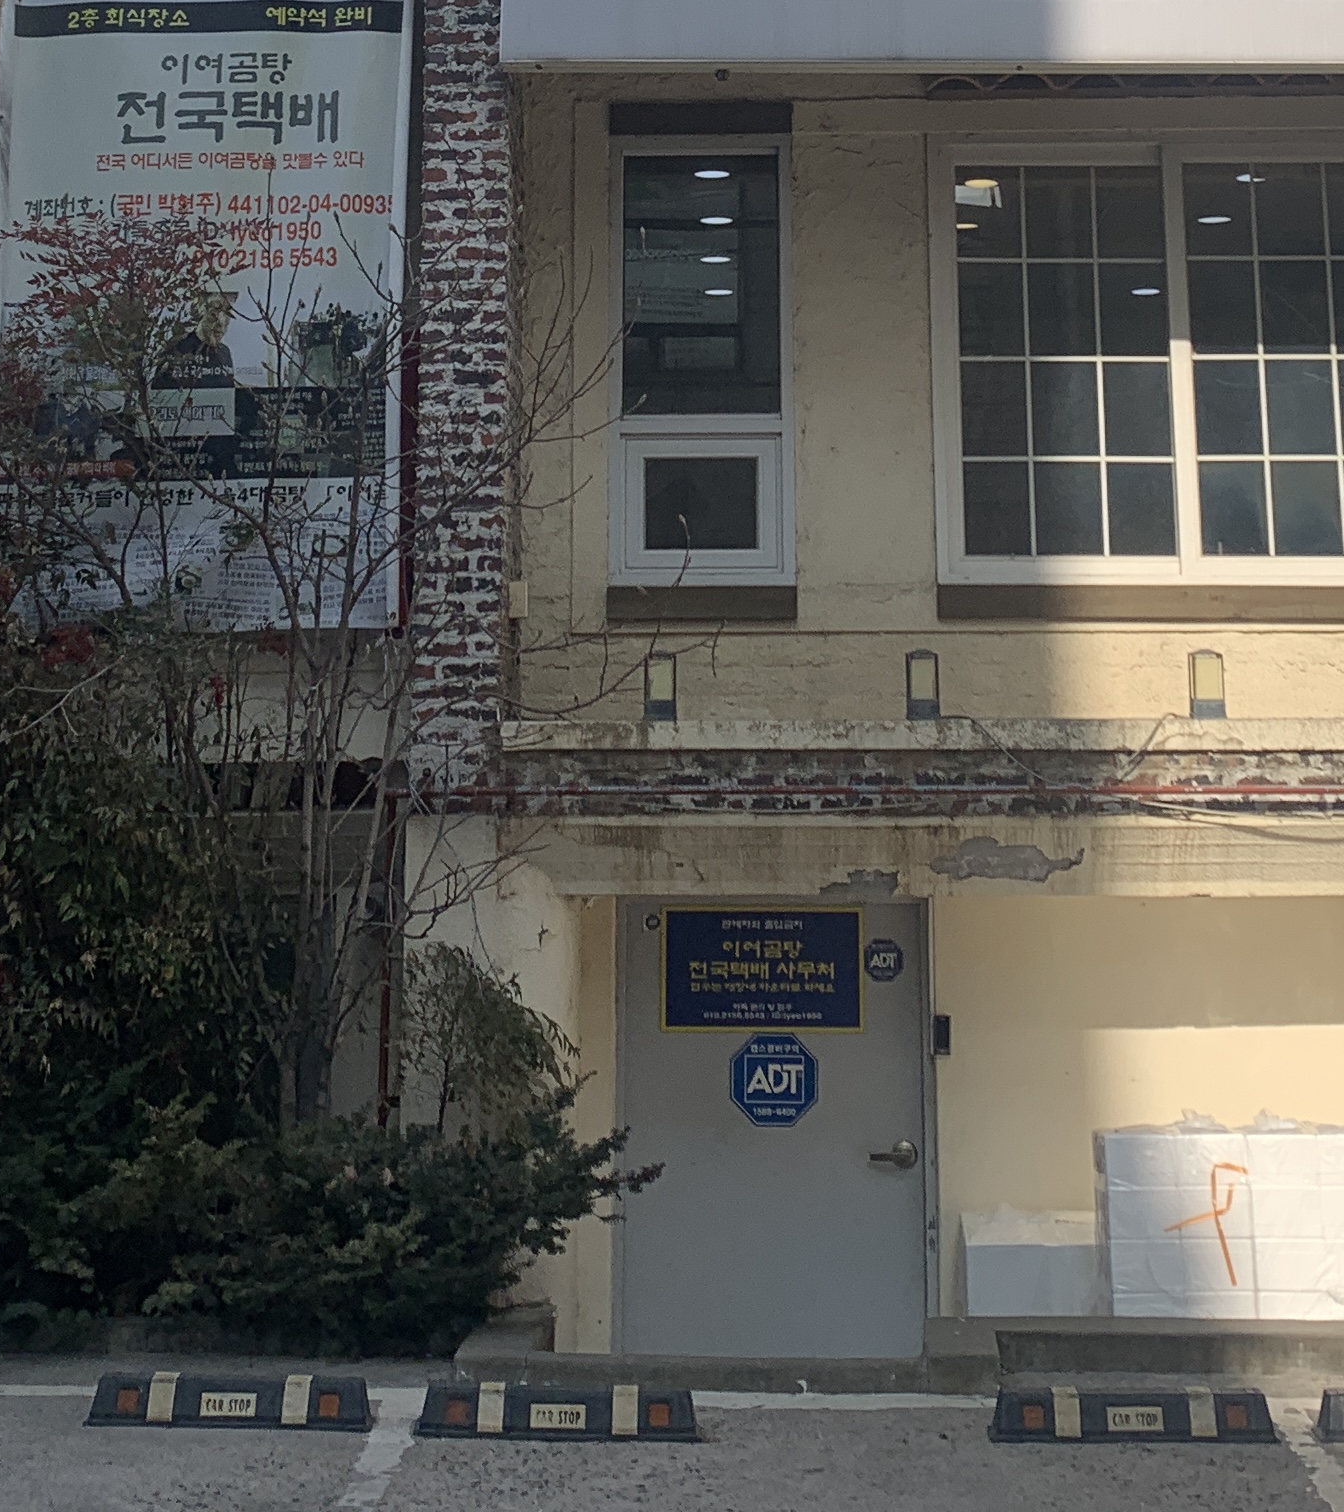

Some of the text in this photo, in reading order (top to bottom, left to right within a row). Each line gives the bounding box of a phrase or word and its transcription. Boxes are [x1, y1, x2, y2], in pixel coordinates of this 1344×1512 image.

[68, 5, 373, 29] 2층 회식장소 예약석 완비
[161, 52, 293, 85] 이여곰탕
[117, 89, 339, 145] 전국택배
[96, 153, 126, 172] 전국
[131, 152, 193, 170] 어디서든
[198, 151, 277, 170] 이여곰탕을
[333, 150, 365, 169] 있다
[689, 960, 770, 980] 전국택배
[869, 952, 898, 968] ADT
[747, 1063, 805, 1095] ADT
[205, 1398, 251, 1413] CAR STOP
[558, 1410, 581, 1425] STOP
[1112, 1413, 1131, 1427] CAR
